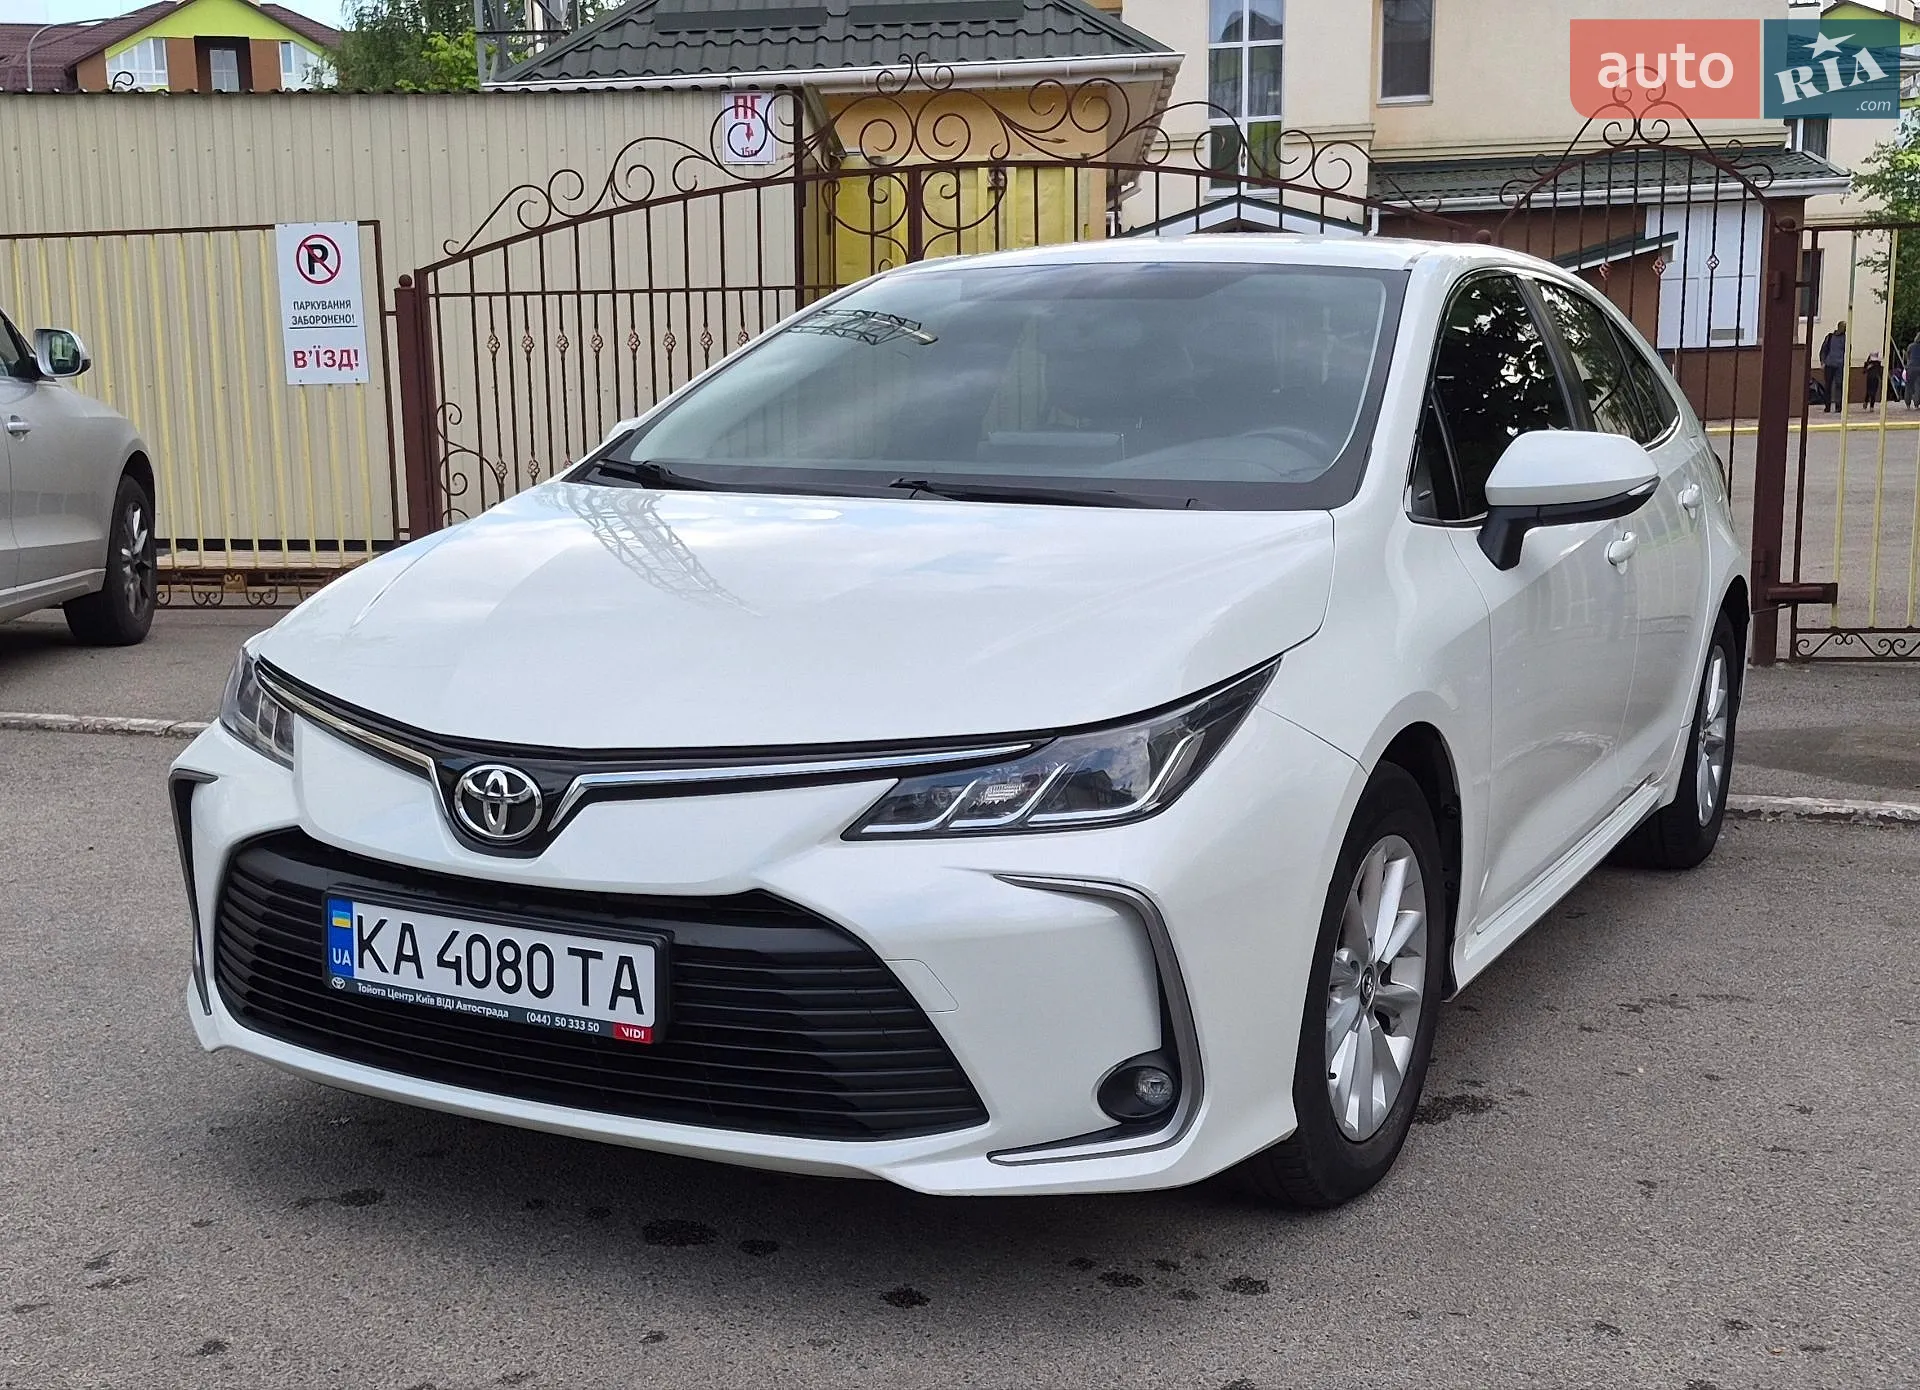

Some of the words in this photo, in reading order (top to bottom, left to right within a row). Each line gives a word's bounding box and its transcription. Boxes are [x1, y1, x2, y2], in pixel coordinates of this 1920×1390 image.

[734, 95, 762, 119] ПГ
[293, 300, 352, 311] ПАРКУВАННЯ
[291, 314, 355, 326] ЗАБОРОНЕНО!
[293, 345, 359, 371] В'ЇЗД!
[332, 947, 352, 966] UA
[357, 914, 424, 979] KA
[437, 930, 555, 999] 4080
[567, 946, 645, 1015] TA
[357, 982, 386, 997] Тойота
[387, 988, 414, 1003] Центр
[416, 994, 435, 1006] Київ
[436, 998, 454, 1010] ВІДІ
[456, 1002, 509, 1018] Автострада
[526, 1011, 551, 1026] (044)
[554, 1018, 567, 1028] 50
[568, 1020, 586, 1031] 333
[588, 1022, 600, 1033] 50
[621, 1026, 645, 1040] VIDI
